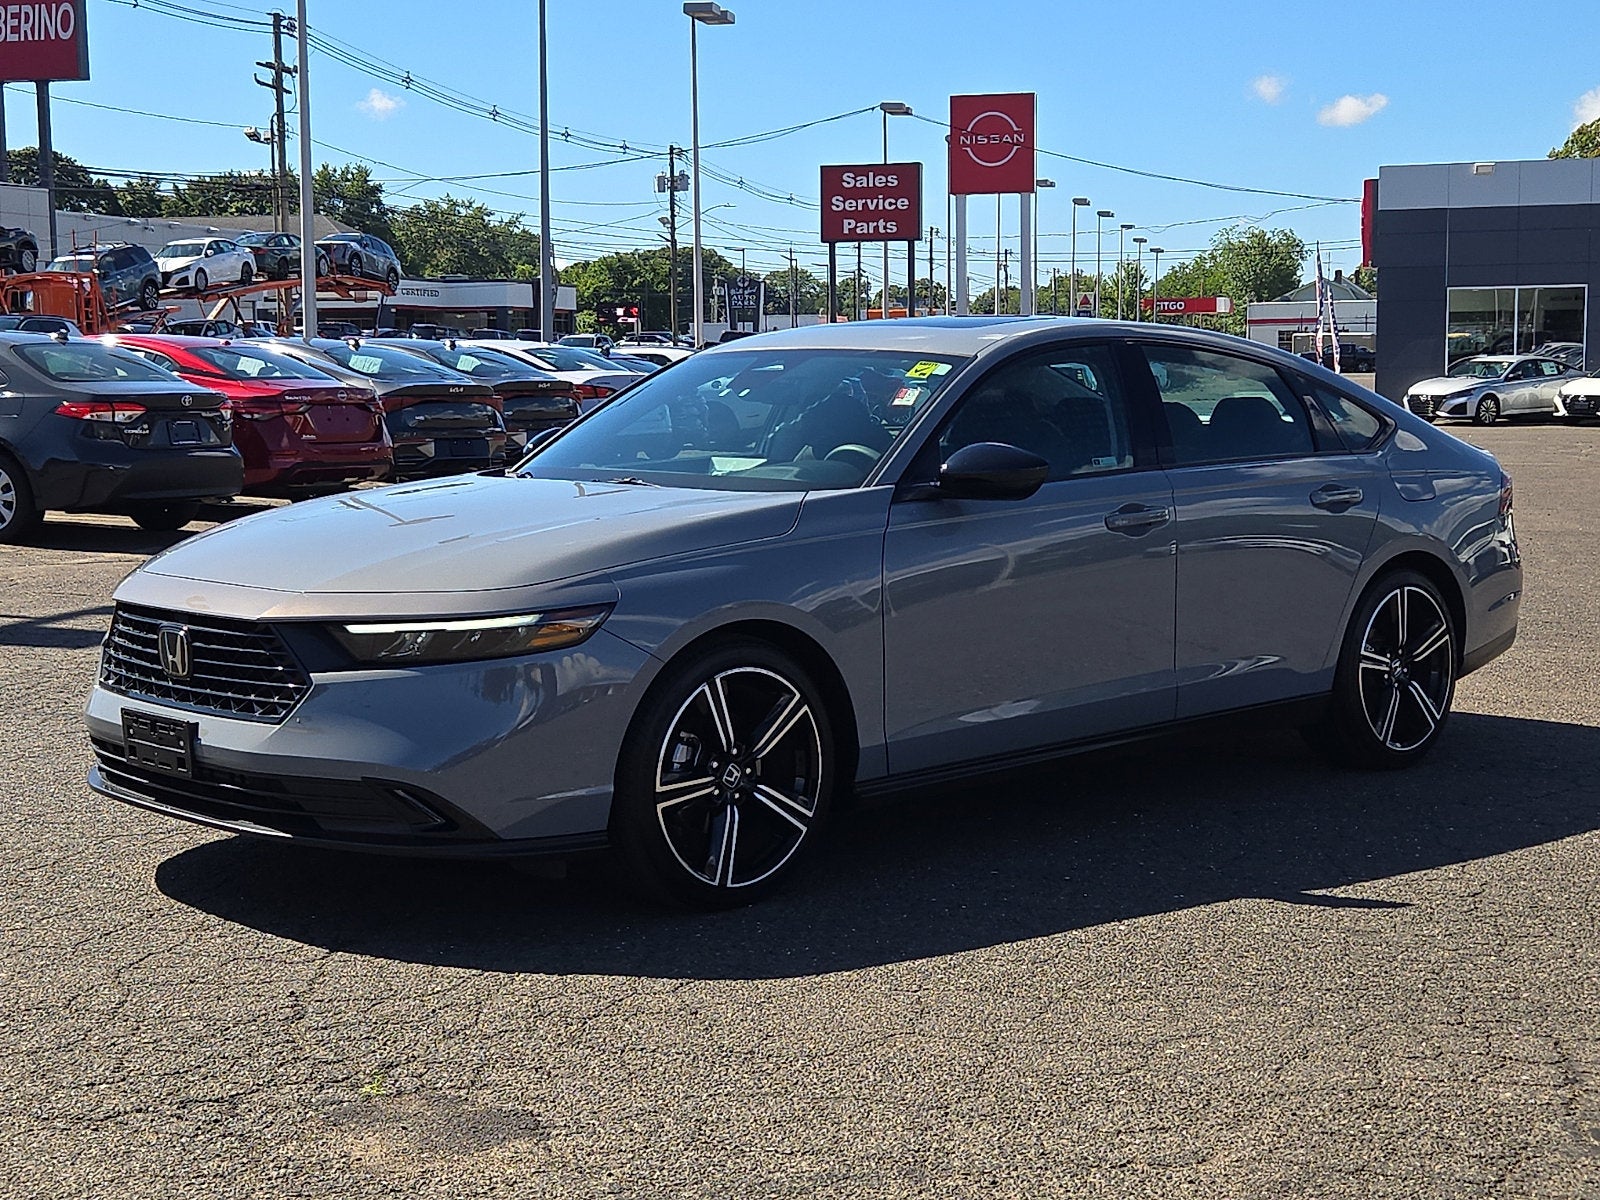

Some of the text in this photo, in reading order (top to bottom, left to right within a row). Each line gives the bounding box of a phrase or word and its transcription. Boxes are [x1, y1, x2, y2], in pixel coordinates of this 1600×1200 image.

[960, 133, 1025, 145] NISSAN
[842, 171, 899, 188] Sales
[831, 194, 909, 211] Service
[843, 218, 897, 234] Parts
[401, 288, 440, 298] CERTIFIED
